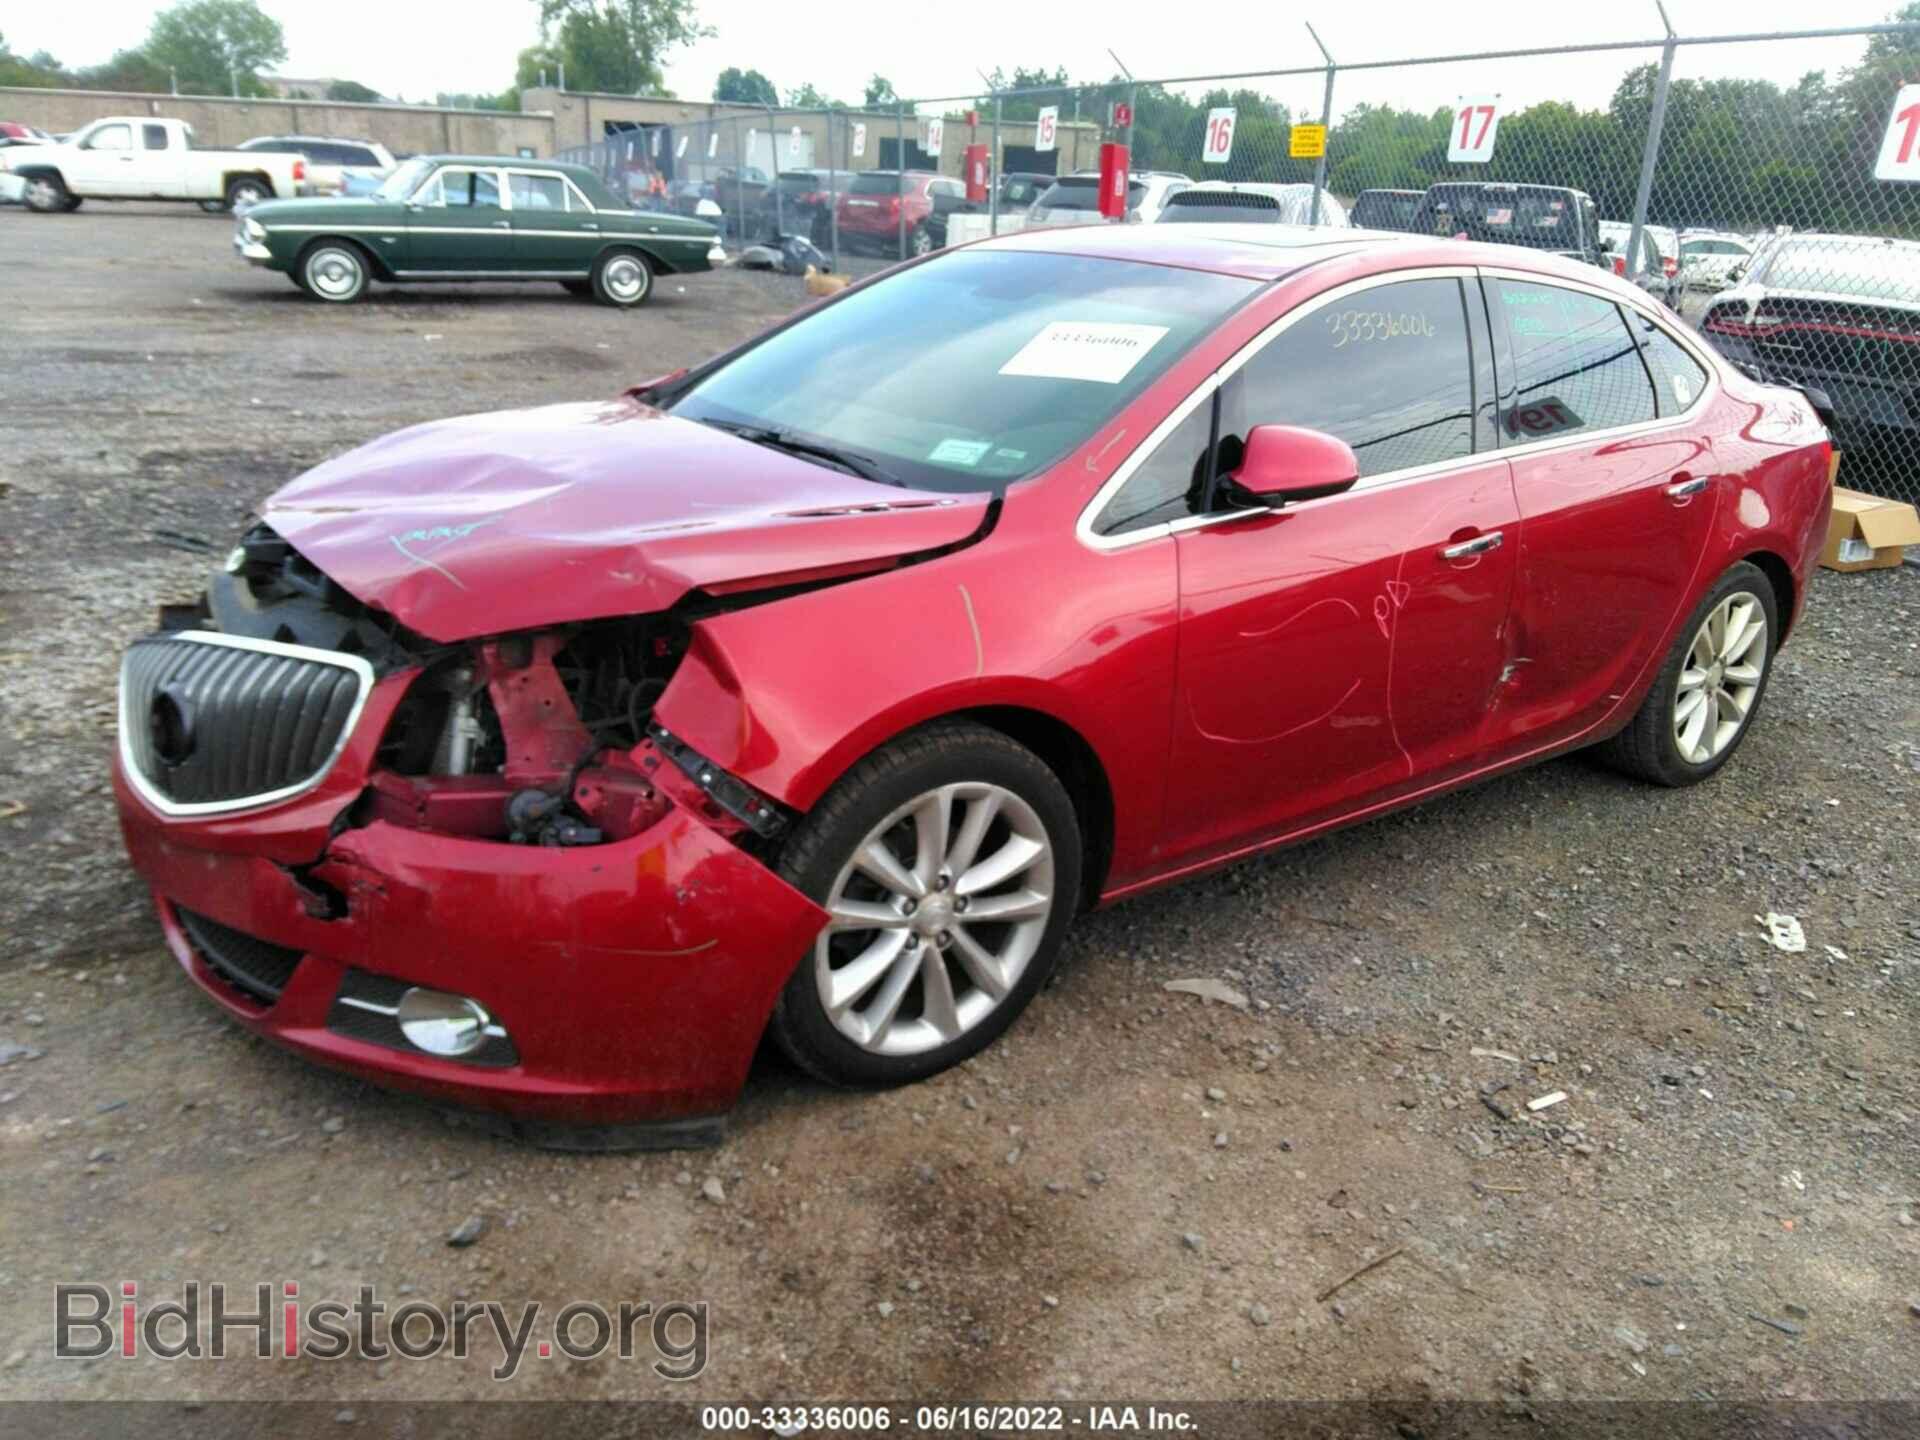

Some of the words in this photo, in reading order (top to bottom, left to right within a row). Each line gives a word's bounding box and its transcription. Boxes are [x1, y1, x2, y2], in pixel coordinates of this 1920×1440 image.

[1040, 114, 1055, 143] 15
[1209, 118, 1231, 153] 16
[1458, 105, 1495, 150] 17
[1896, 102, 1920, 163] 1
